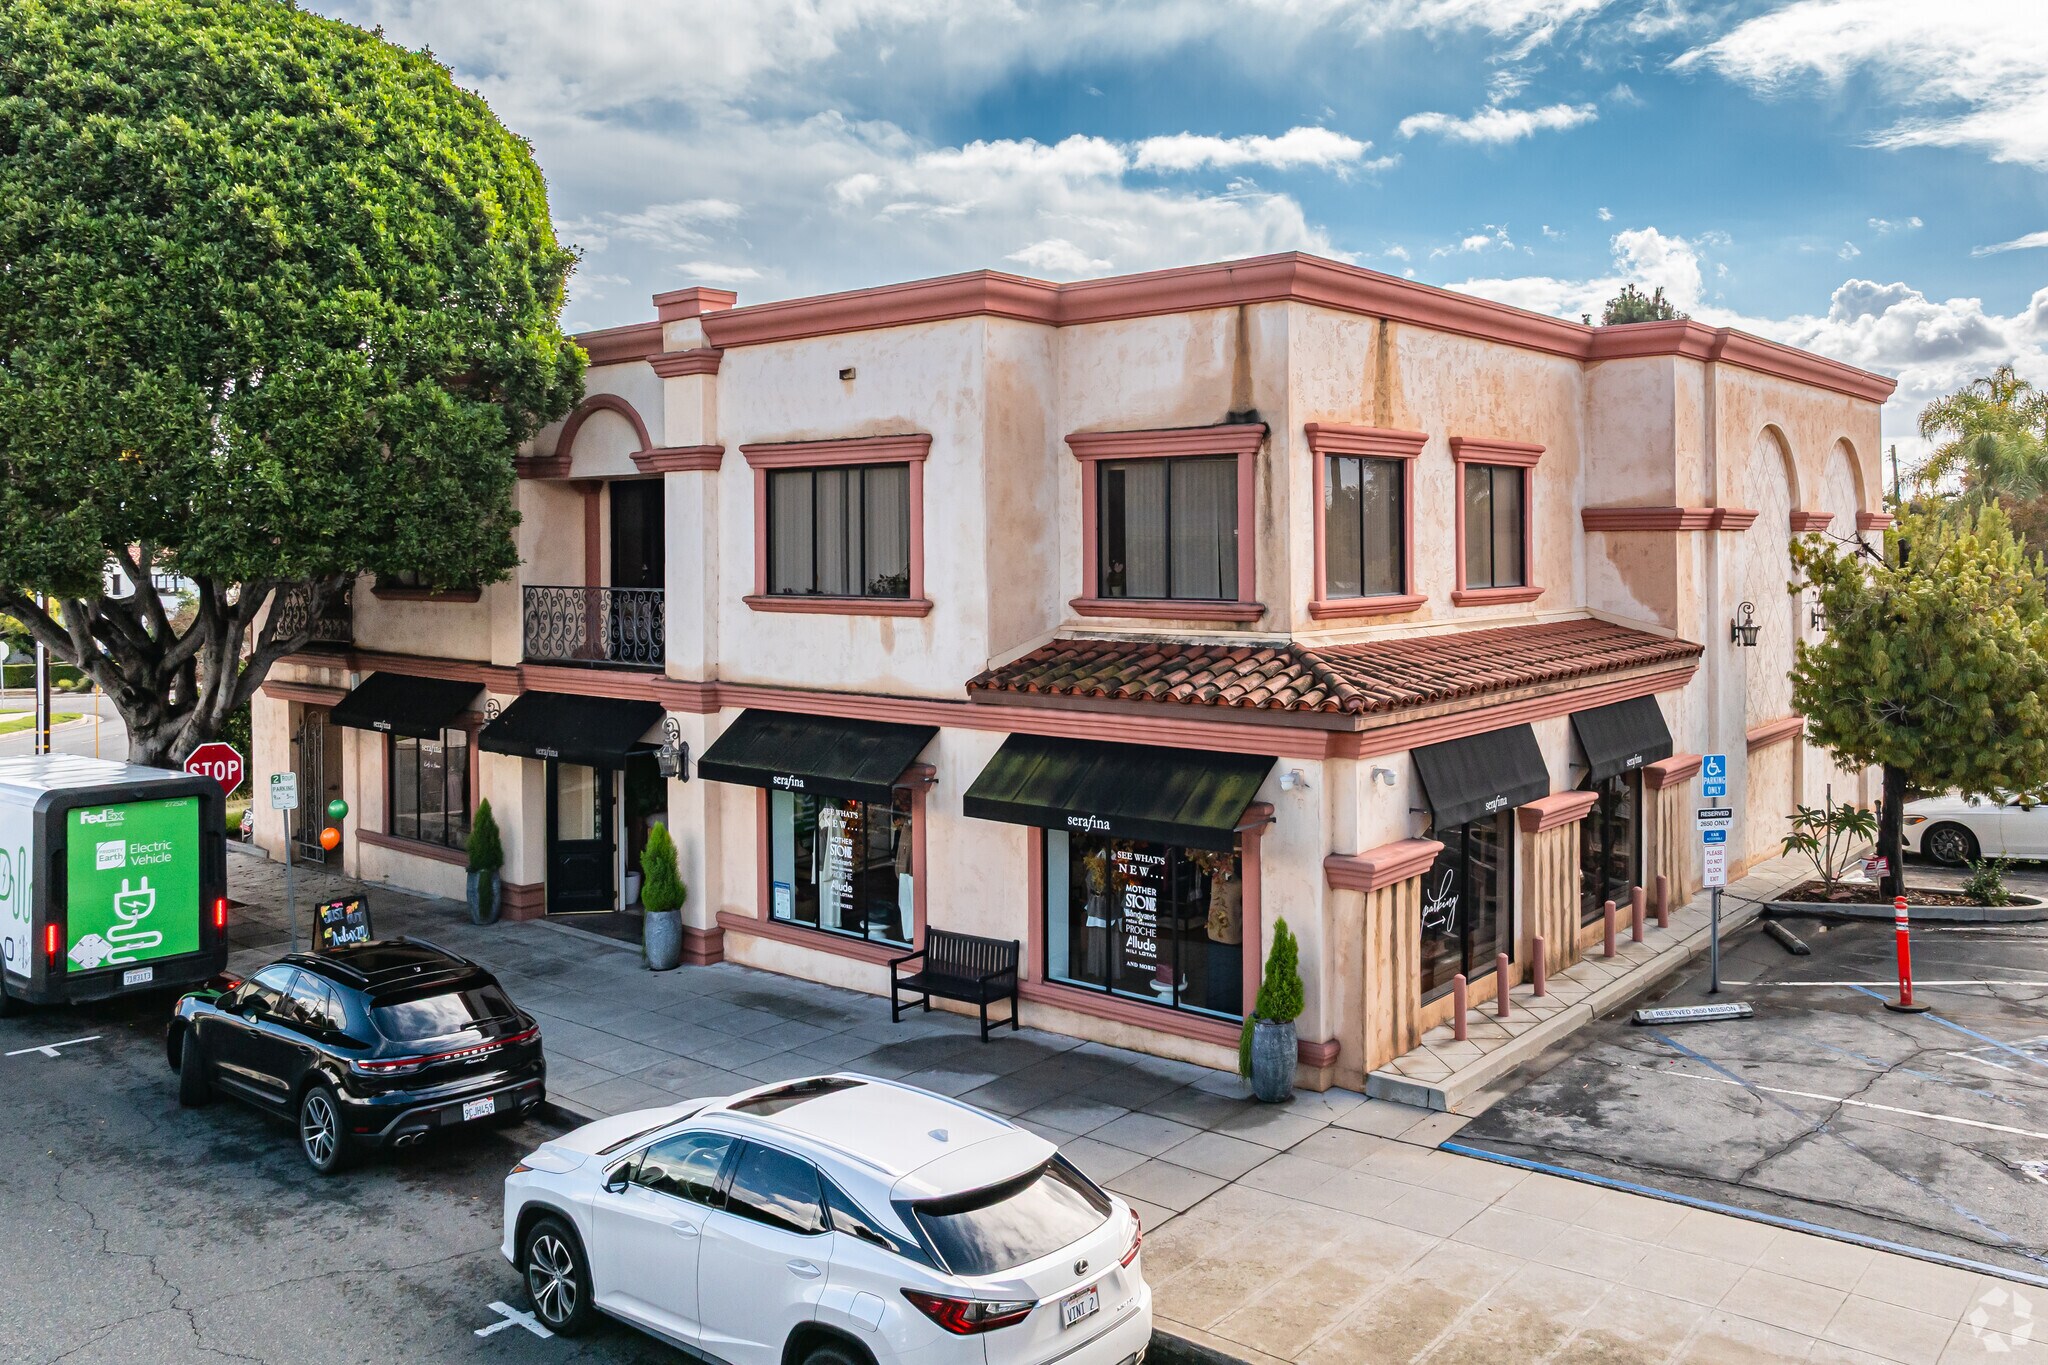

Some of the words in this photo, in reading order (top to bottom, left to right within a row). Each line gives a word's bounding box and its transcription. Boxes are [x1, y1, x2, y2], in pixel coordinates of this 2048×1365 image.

[189, 760, 239, 781] STOP
[273, 775, 280, 784] 2
[772, 774, 805, 790] serafina
[1703, 776, 1726, 785] PARKING
[1707, 786, 1722, 795] ONLY
[1485, 794, 1508, 813] serafina
[80, 808, 125, 825] FedEx
[1700, 810, 1730, 818] RESERVED
[1067, 815, 1111, 832] serafina
[130, 840, 172, 854] Electric
[98, 853, 124, 863] Earth
[130, 852, 172, 866] Vehicle
[1117, 850, 1133, 860] SEE
[1133, 853, 1166, 866] WHAT'S
[1125, 884, 1157, 896] MOTHER
[1125, 893, 1157, 912] STONE
[1125, 923, 1157, 938] PROCHE
[1125, 934, 1157, 952] Allude
[1708, 1005, 1737, 1013] MISSION
[1066, 1301, 1086, 1322] VINI
[1089, 1296, 1095, 1311] 2
